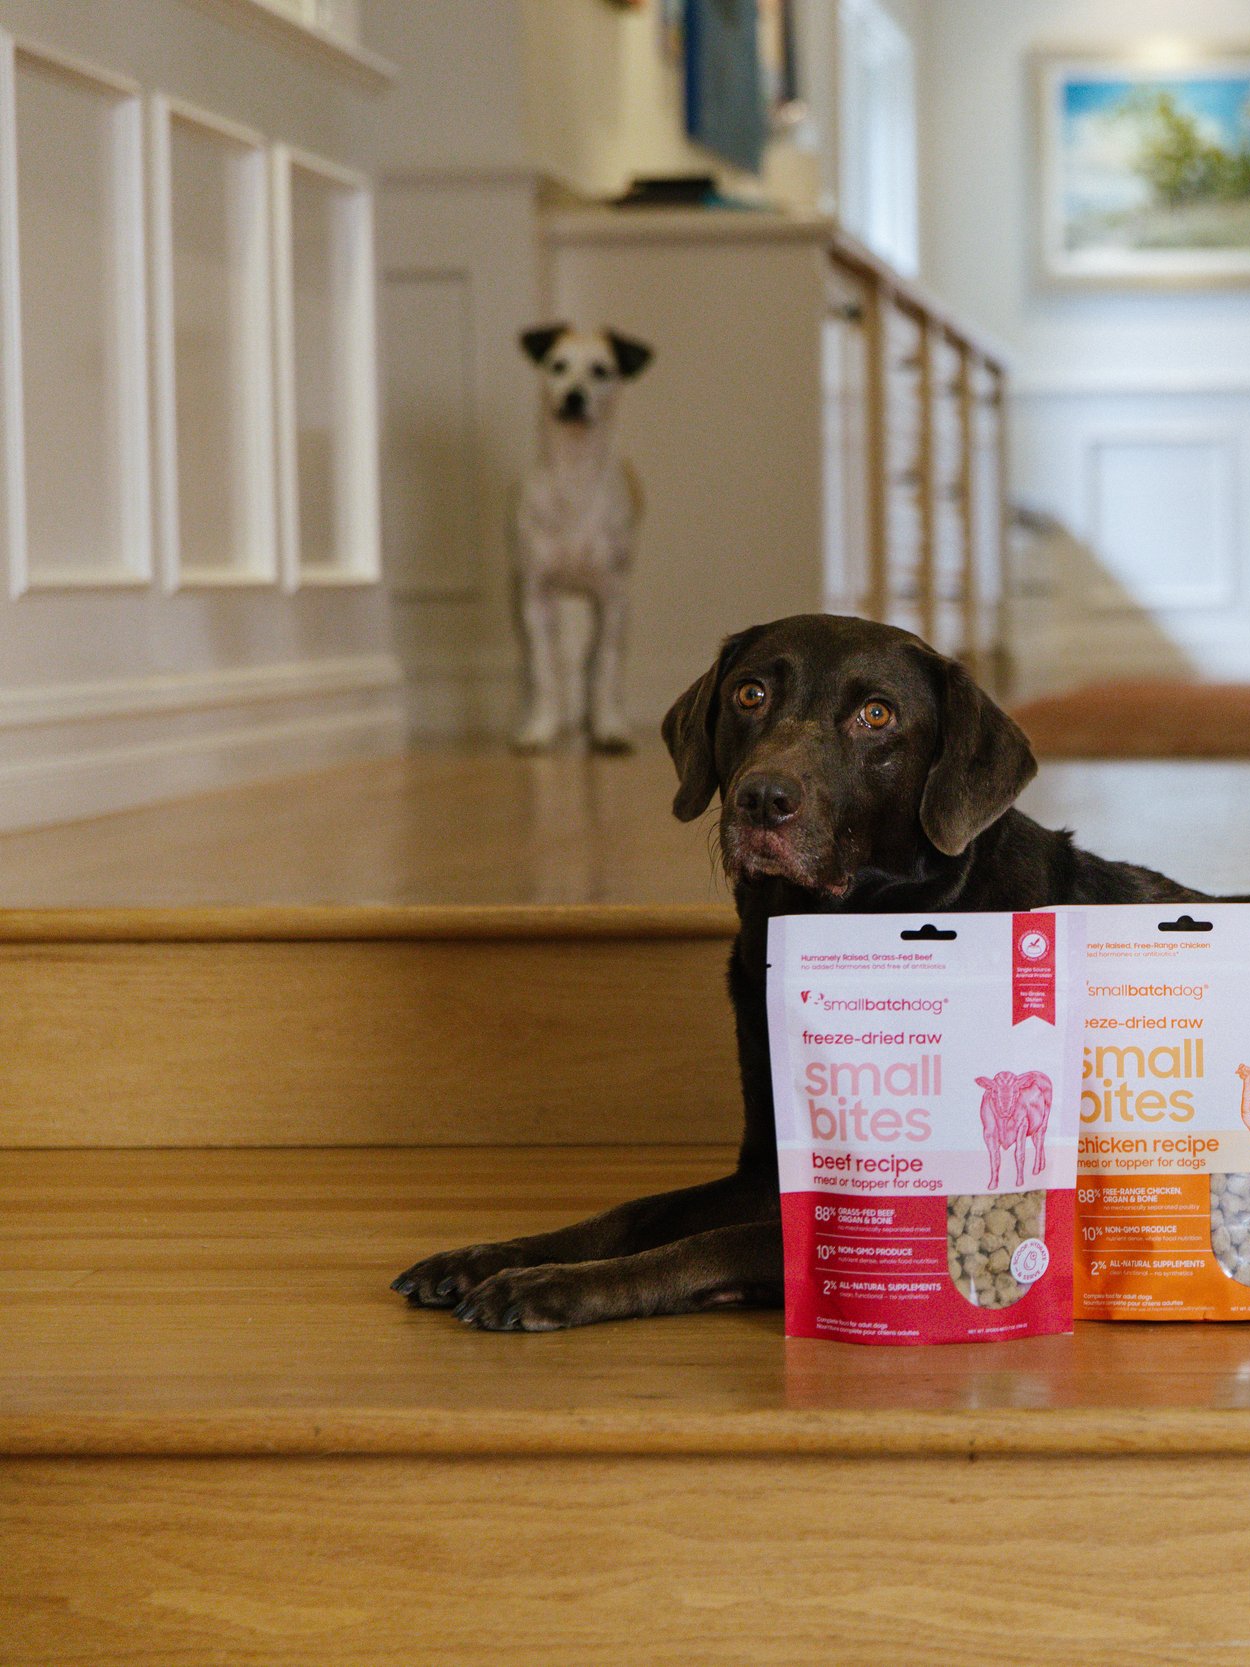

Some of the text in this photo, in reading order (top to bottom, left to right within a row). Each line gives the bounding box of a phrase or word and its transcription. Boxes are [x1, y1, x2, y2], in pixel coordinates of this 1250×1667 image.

[1134, 943, 1178, 951] Free-Range
[801, 954, 841, 963] Humanely
[1171, 1018, 1204, 1029] raw
[802, 1031, 942, 1045] freeze-dried raw
[805, 1054, 942, 1096] small
[808, 1097, 932, 1143] bites
[1078, 1135, 1220, 1157] chicken recipe
[812, 1152, 923, 1177] beef recipe
[1077, 1156, 1206, 1170] meal or topper for dogs
[814, 1175, 943, 1191] meal or topper for dogs
[1078, 1189, 1100, 1203] 88%
[1103, 1187, 1145, 1196] FREE-RANGE
[1103, 1195, 1158, 1203] ORGAN & BONE
[815, 1205, 836, 1221] 88%
[838, 1207, 876, 1217] GRASS-FED
[838, 1215, 893, 1225] ORGAN & BONE
[1082, 1226, 1103, 1241] 10%
[1141, 1225, 1177, 1233] PRODUCE
[816, 1245, 836, 1260] 10%
[838, 1246, 913, 1256] NON-GMO PRODUCE
[1090, 1261, 1107, 1276] 2%
[1110, 1260, 1205, 1268] ALL-NATURAL SUPPLEMENTS
[823, 1280, 837, 1295] 2%
[839, 1281, 941, 1292] ALL-NATURAL SUPPLEMENTS
